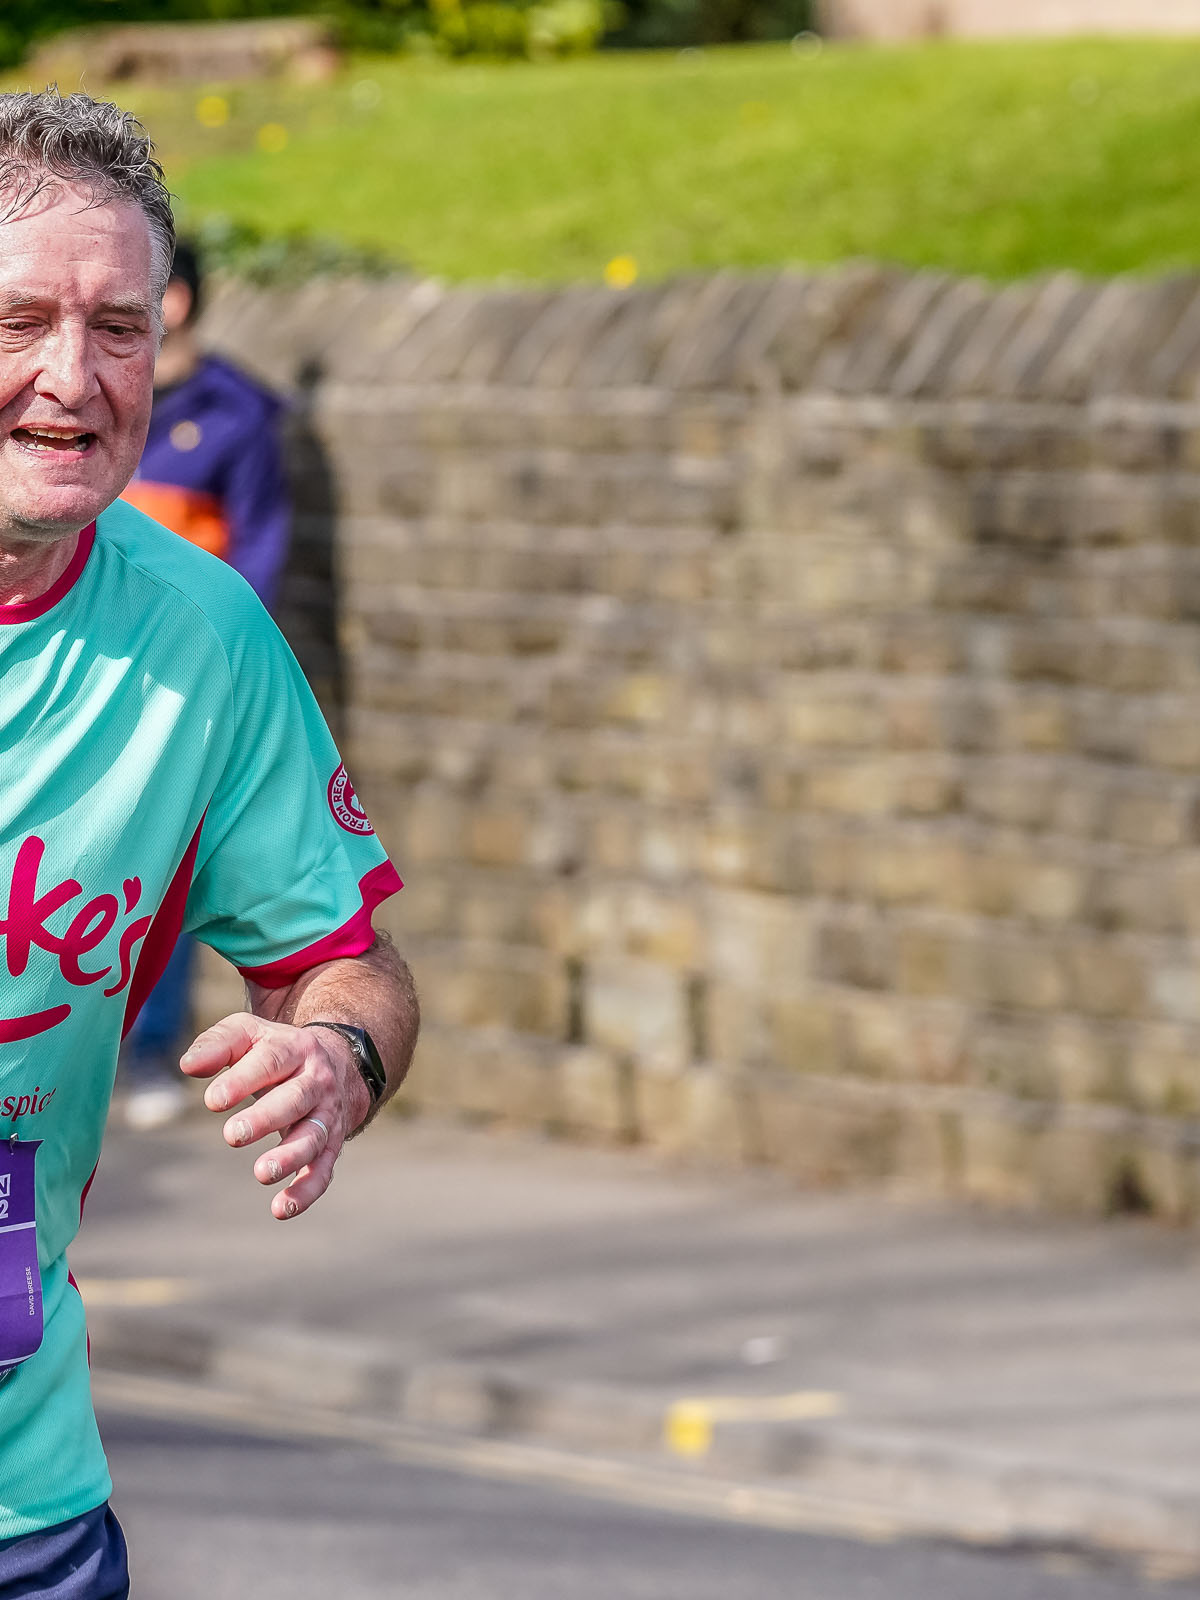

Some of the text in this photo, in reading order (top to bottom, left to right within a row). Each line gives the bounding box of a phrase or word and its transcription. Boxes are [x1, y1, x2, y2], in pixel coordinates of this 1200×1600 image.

[333, 770, 365, 830] FROM RECY
[25, 1266, 34, 1294] BREESE
